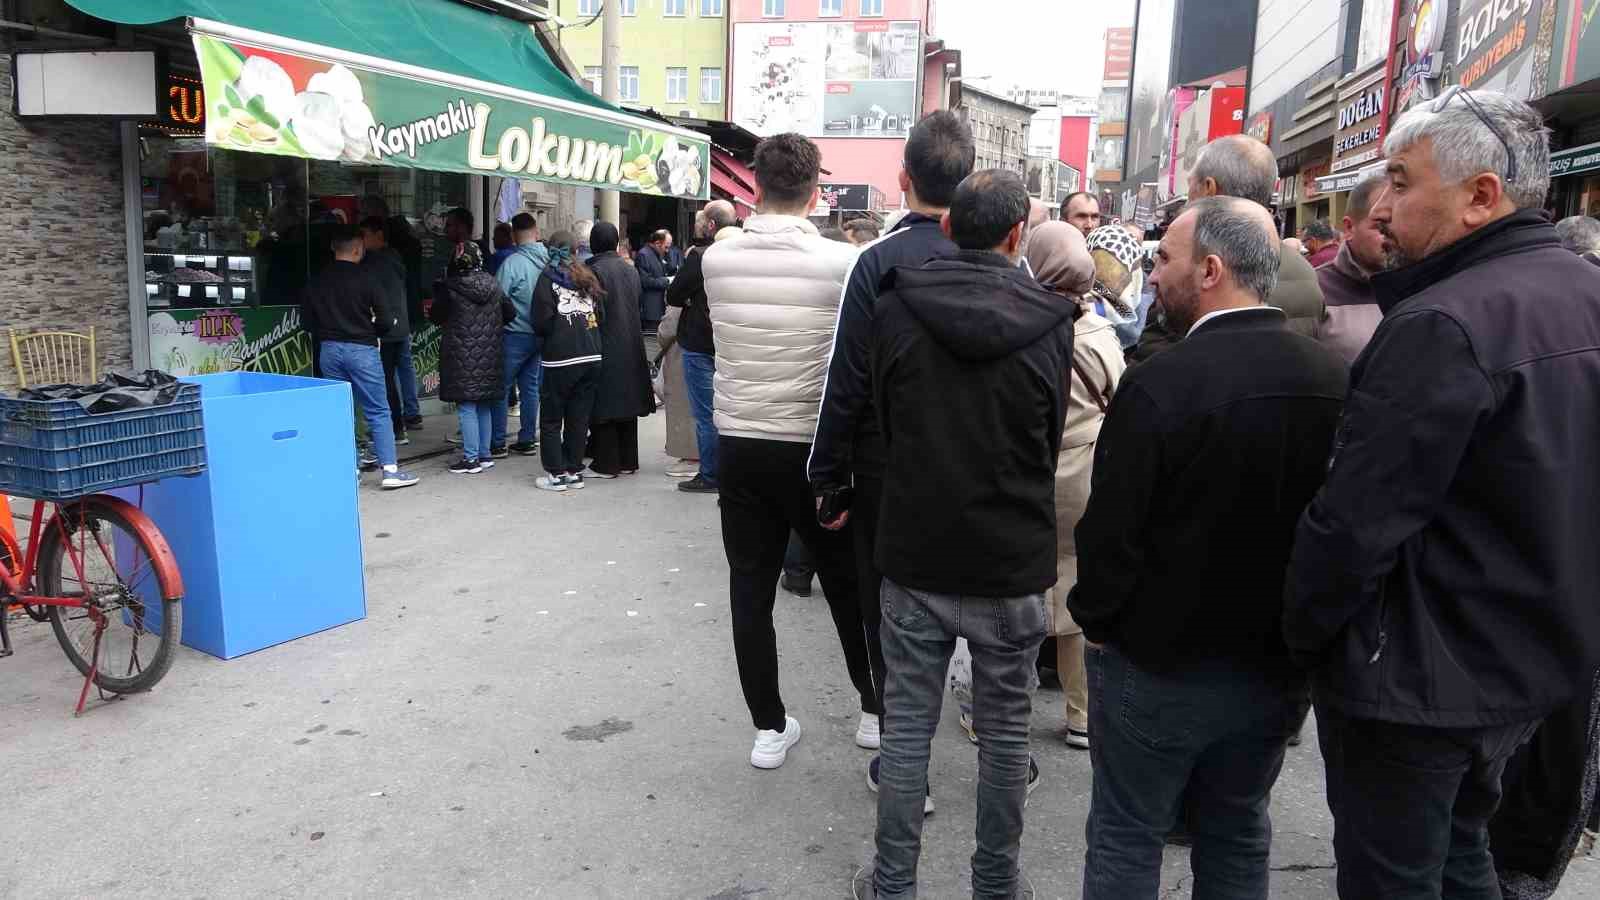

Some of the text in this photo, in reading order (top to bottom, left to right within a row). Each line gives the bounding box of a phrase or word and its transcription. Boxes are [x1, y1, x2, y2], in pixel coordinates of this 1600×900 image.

[1460, 18, 1527, 88] KURUYEMİŞ
[1338, 87, 1384, 130] DOĞAN
[369, 98, 624, 184] Kaymaklı Lokum
[1336, 126, 1381, 157] ŞEKERLEME
[200, 313, 240, 338] İLK
